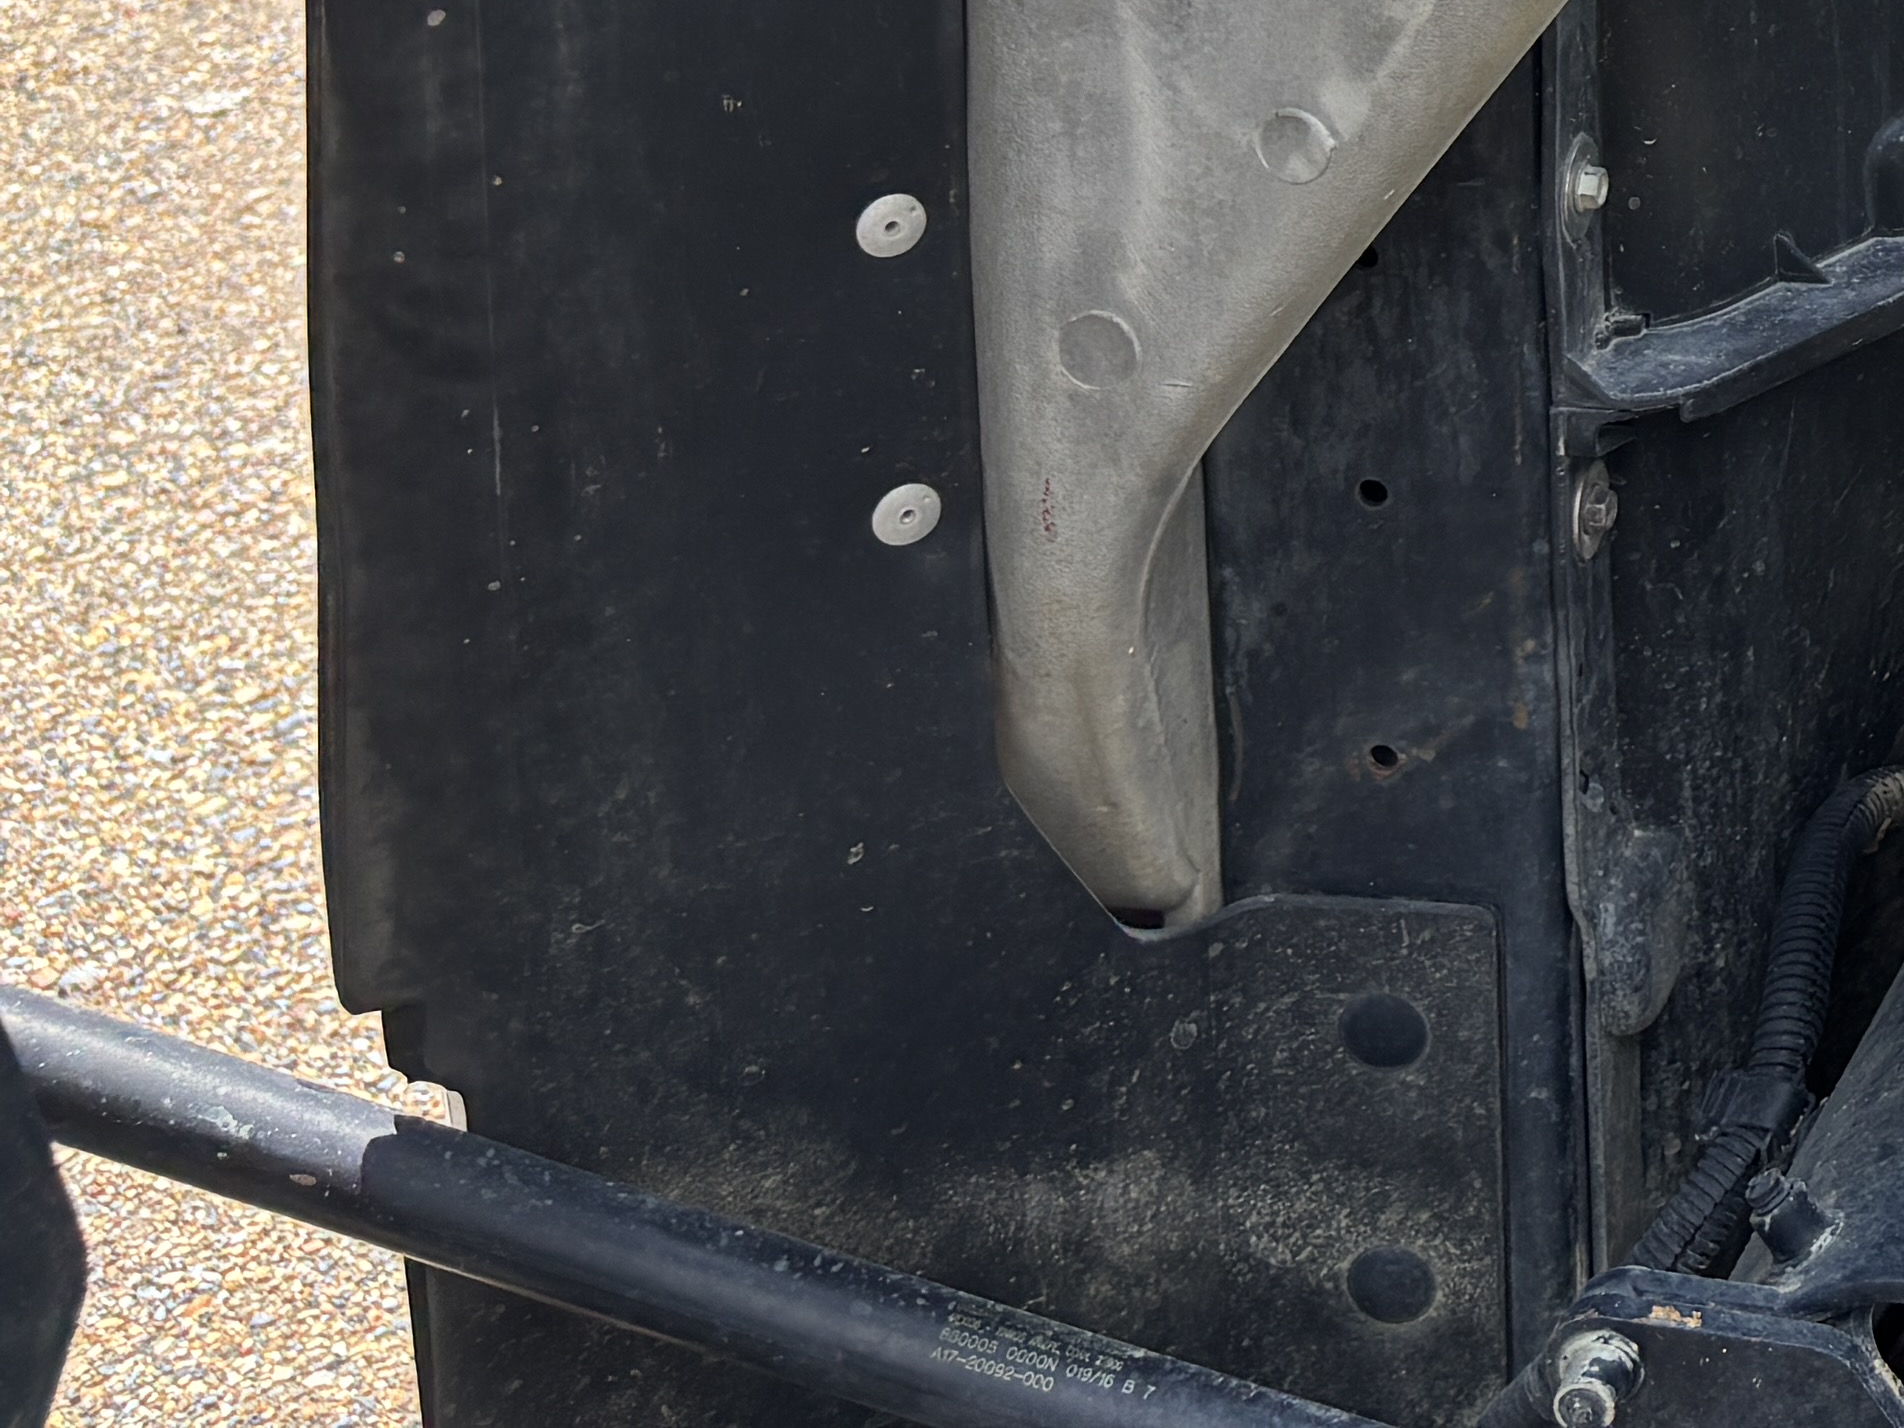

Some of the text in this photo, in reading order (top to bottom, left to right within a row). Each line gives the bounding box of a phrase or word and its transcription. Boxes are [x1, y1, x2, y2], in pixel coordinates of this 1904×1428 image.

[930, 1346, 1055, 1392] A17-20092-000
[1066, 1362, 1115, 1388] 019/16
[1142, 1384, 1157, 1400] 7
